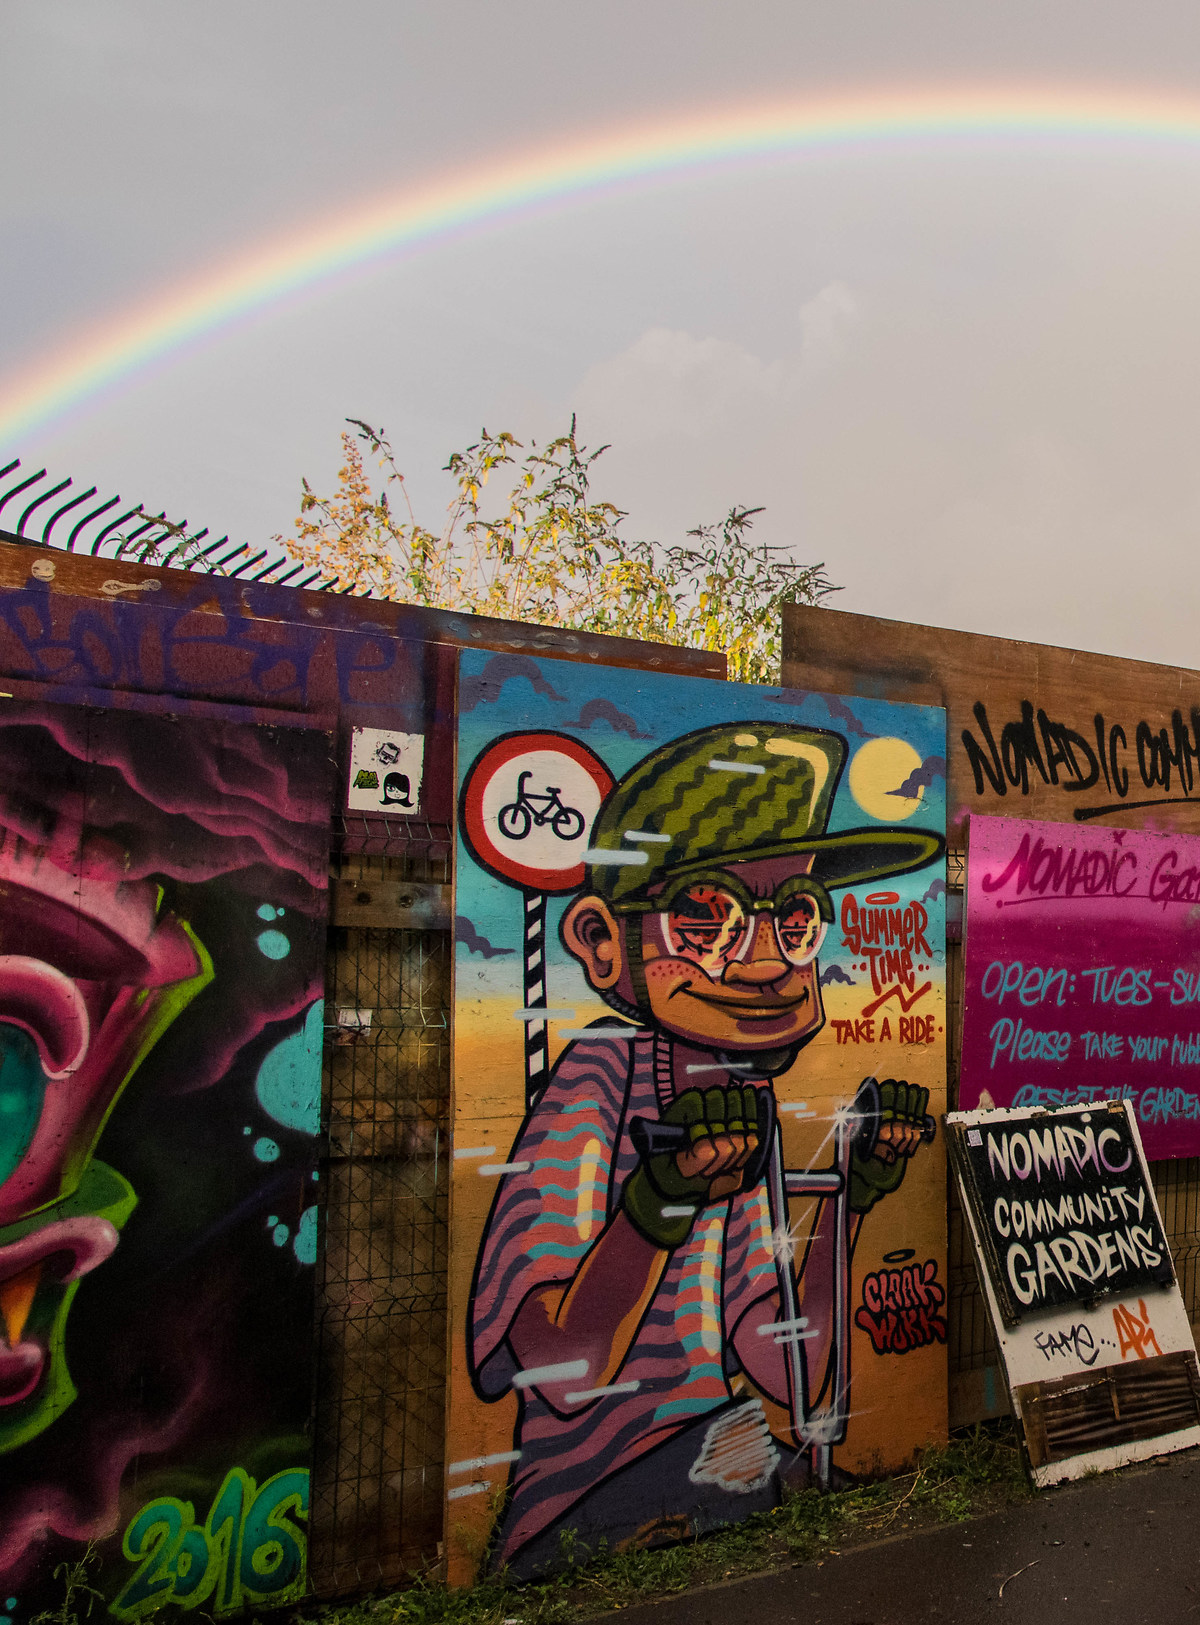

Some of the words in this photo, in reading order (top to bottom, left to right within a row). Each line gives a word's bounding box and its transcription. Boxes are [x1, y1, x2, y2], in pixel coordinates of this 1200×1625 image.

[961, 701, 1129, 797] NOMADIC
[831, 1018, 875, 1045] TAKE
[879, 1016, 892, 1043] A
[110, 1467, 311, 1615] 2016
